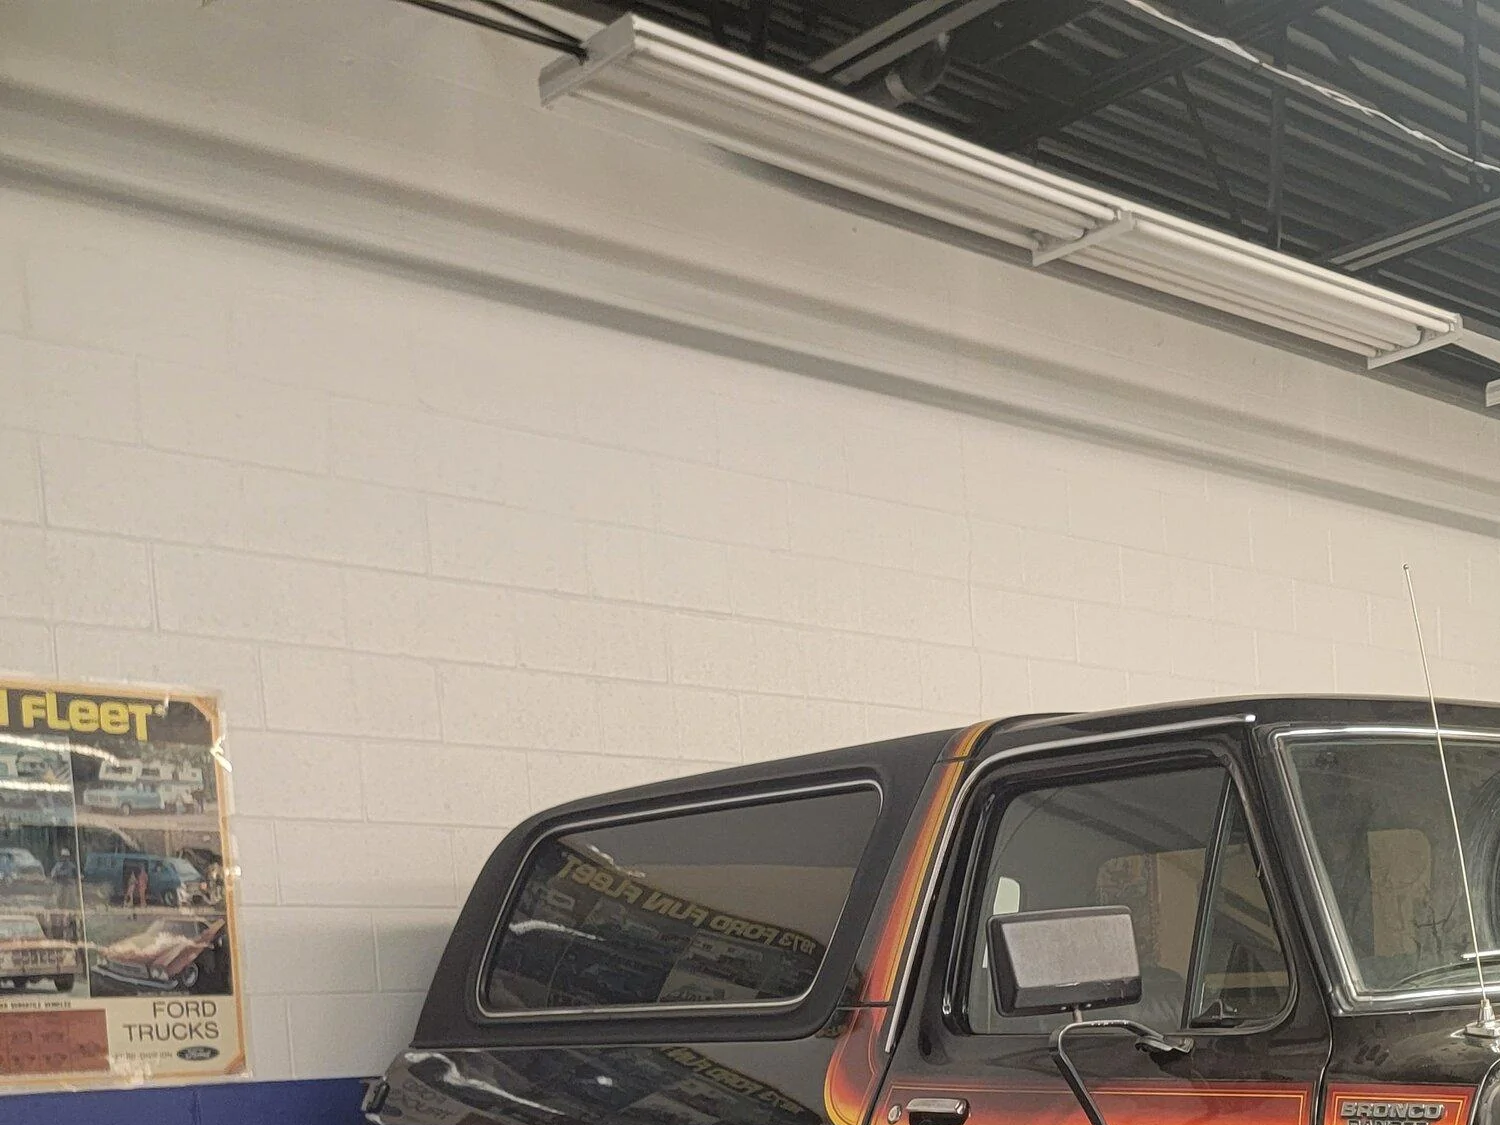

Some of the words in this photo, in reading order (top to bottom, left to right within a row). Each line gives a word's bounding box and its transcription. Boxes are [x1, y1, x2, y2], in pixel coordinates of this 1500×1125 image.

[152, 1000, 217, 1019] FORD
[122, 1021, 220, 1042] TRUCKS
[1340, 1101, 1445, 1120] BRONCO
